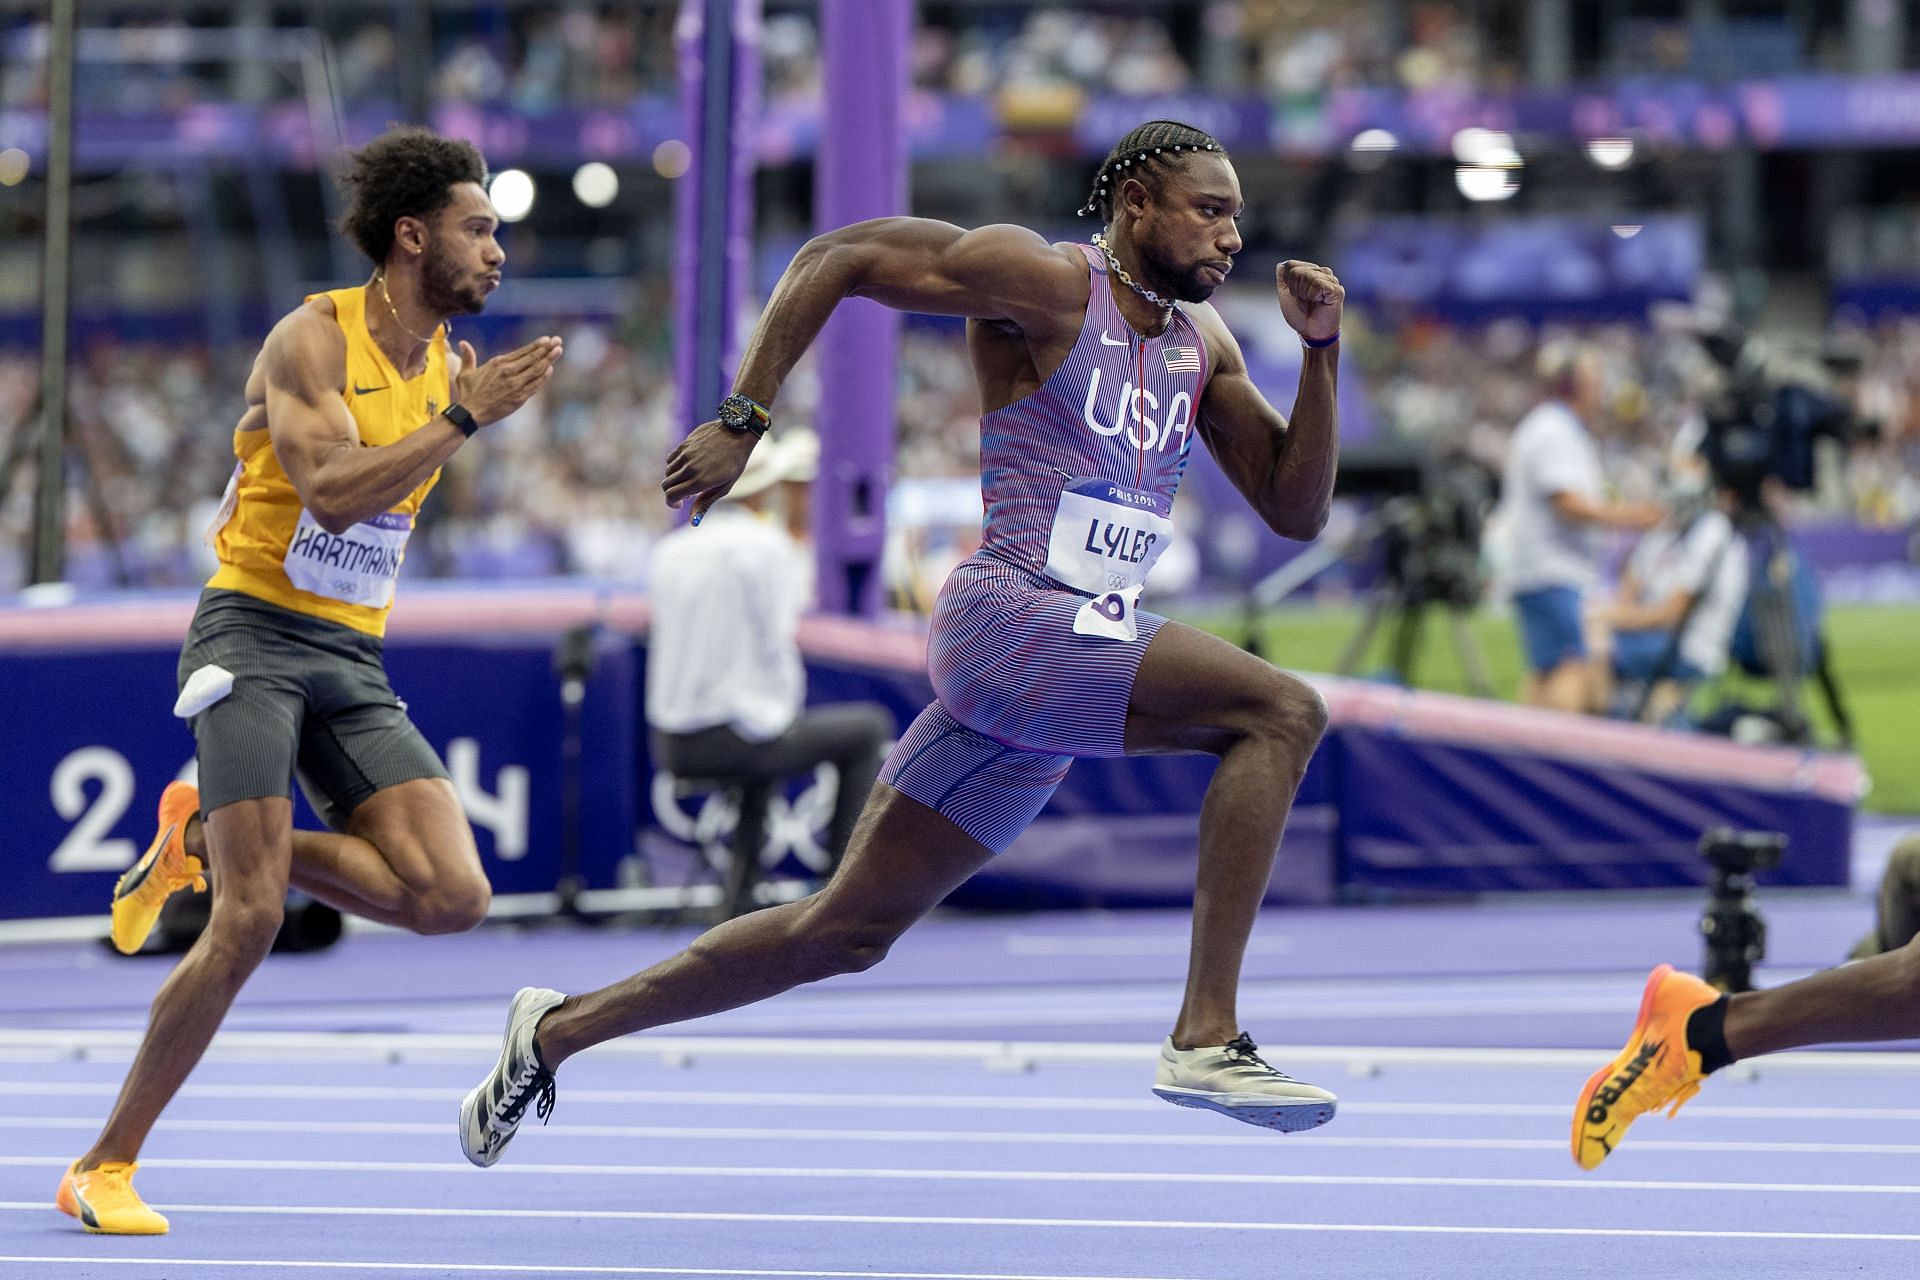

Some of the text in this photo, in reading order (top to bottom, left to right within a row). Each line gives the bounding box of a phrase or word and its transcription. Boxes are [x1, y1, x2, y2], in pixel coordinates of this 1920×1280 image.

[1084, 367, 1191, 455] USA
[1108, 487, 1157, 508] PARIS 2024
[292, 526, 400, 577] HARTMANN
[1085, 518, 1157, 564] LYLES
[1587, 1037, 1664, 1125] NITRO
